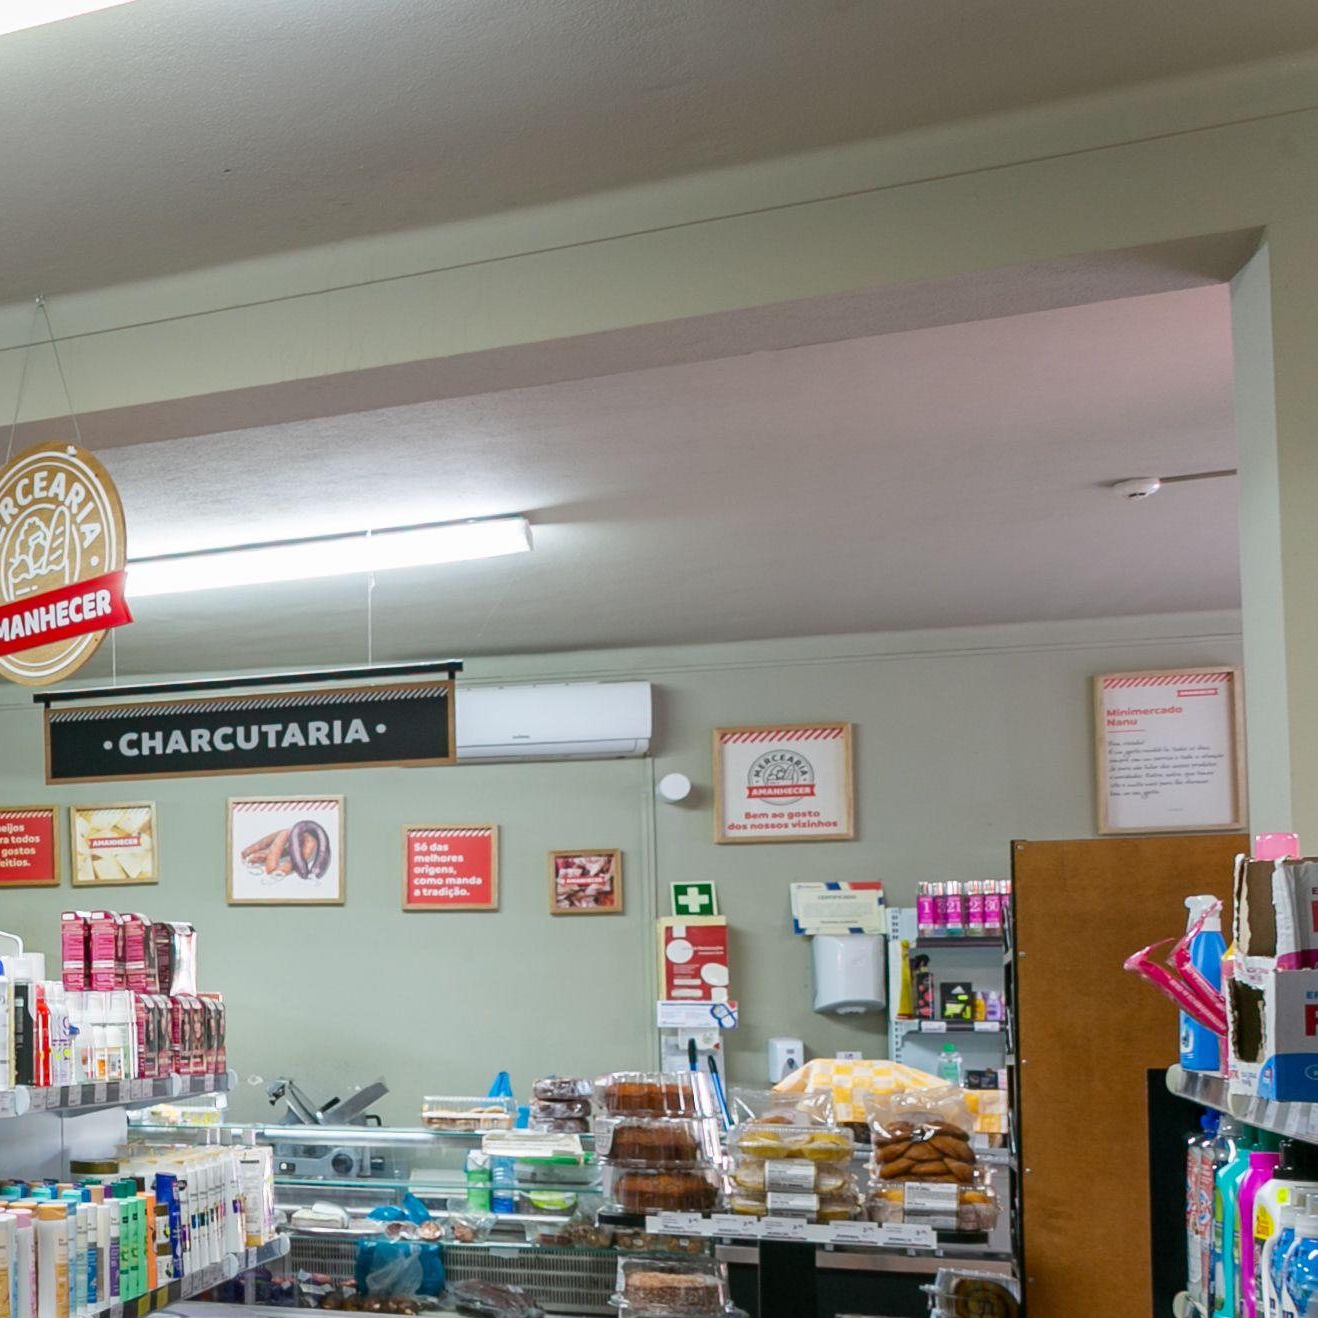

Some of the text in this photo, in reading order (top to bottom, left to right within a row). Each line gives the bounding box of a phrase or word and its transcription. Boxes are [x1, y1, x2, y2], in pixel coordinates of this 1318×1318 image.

[1107, 705, 1183, 717] Minimercado
[1107, 718, 1138, 727] Nanu
[118, 718, 370, 757] CHARCUTARIA
[753, 753, 809, 778] MERCEARIA
[744, 812, 769, 820] Bem
[787, 811, 820, 820] gosto
[727, 820, 838, 831] dos nossos vizinhos
[11, 835, 40, 844] todos
[1, 847, 36, 858] gostos
[413, 842, 448, 852] Só das
[413, 853, 463, 863] melhores
[413, 865, 457, 876] origens,
[413, 876, 482, 885] como manda
[413, 886, 470, 898] a tradição.
